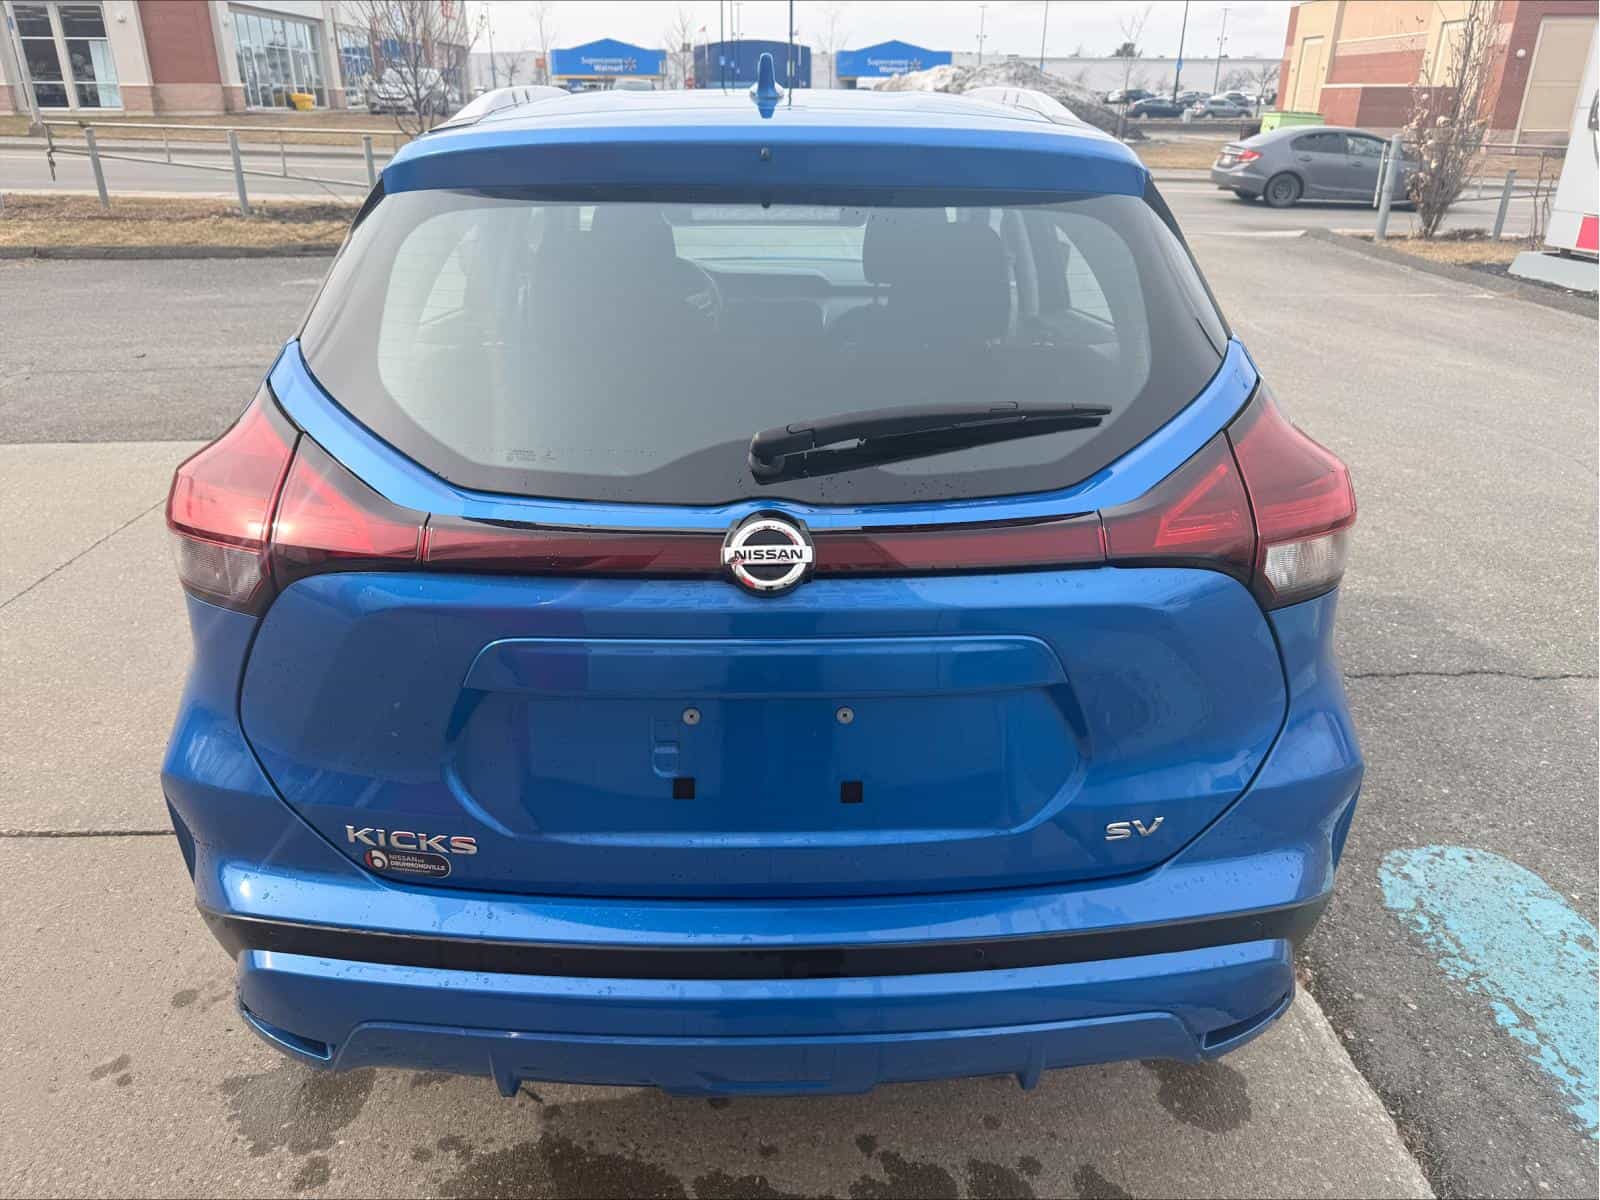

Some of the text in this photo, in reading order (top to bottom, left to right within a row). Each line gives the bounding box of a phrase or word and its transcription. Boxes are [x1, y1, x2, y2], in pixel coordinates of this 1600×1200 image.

[734, 549, 803, 560] NISSAN
[1105, 816, 1165, 840] SV
[345, 825, 478, 855] KICKS
[388, 854, 417, 863] NISSAN
[390, 860, 446, 871] DRUMMONDVILLE
